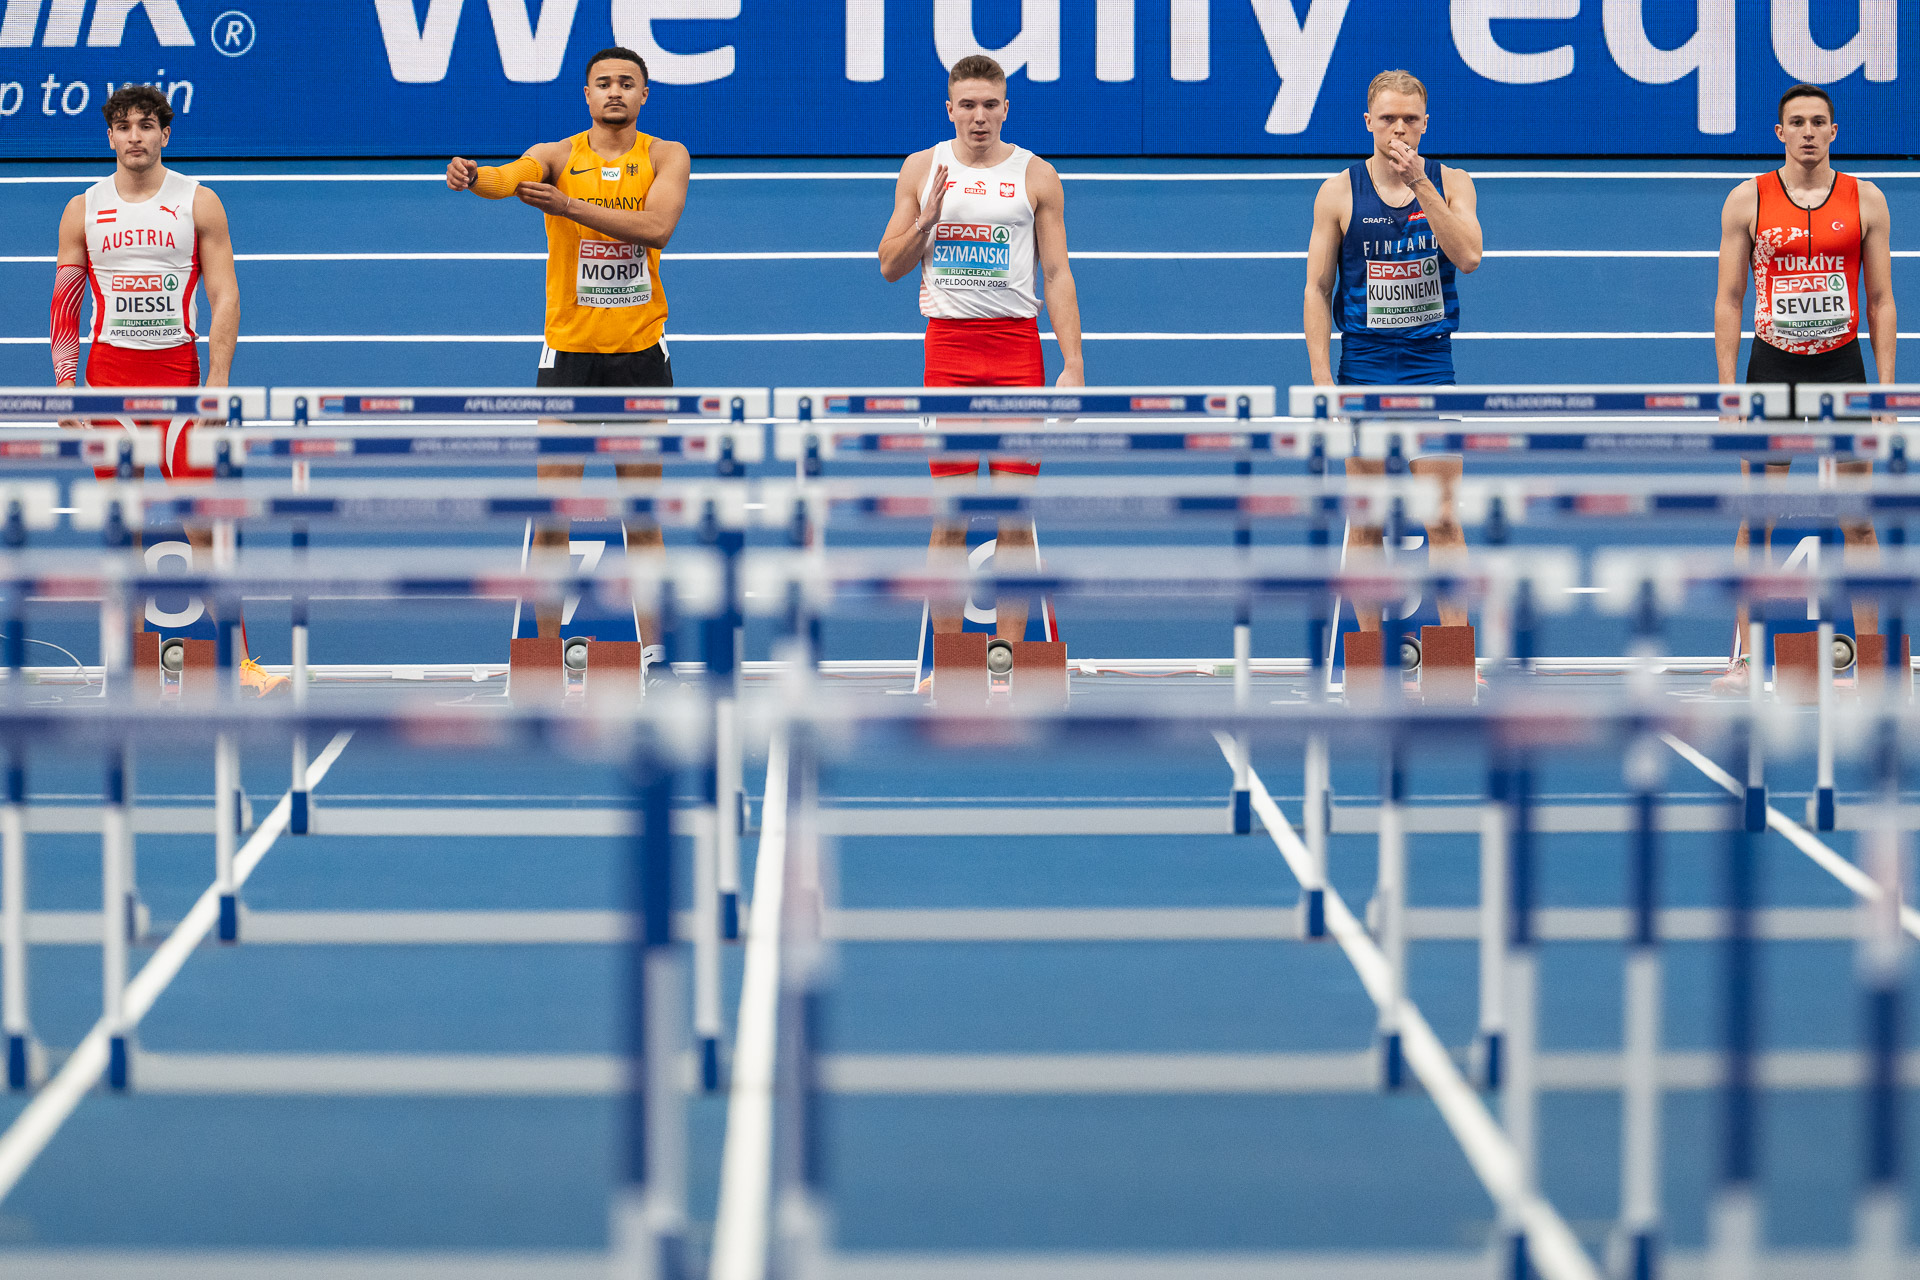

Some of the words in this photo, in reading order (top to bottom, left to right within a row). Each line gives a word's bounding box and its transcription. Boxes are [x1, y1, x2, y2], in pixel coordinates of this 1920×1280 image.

[41, 74, 90, 116] to
[602, 170, 619, 178] WGV
[937, 225, 990, 240] SPAR
[102, 229, 176, 253] AUSTRIA
[1363, 234, 1439, 257] FINLAND
[581, 243, 632, 258] SPAR
[934, 245, 1009, 265] SZYMANSKI
[1774, 252, 1845, 271] TÜRKİYE
[582, 261, 644, 281] MORDI
[1370, 263, 1420, 278] SPAR
[112, 276, 162, 290] SPAR
[612, 286, 635, 294] CLEAN
[987, 280, 1007, 288] 2025
[1368, 279, 1440, 301] KUUSINIEMI
[1775, 276, 1827, 292] SPAR
[116, 296, 175, 312] DIESSL
[632, 293, 650, 302] 2025
[1403, 305, 1427, 313] CLEAN
[1776, 296, 1845, 315] SEVLER
[1424, 312, 1443, 322] 2025
[162, 327, 181, 336] 2025
[561, 541, 606, 625] 7
